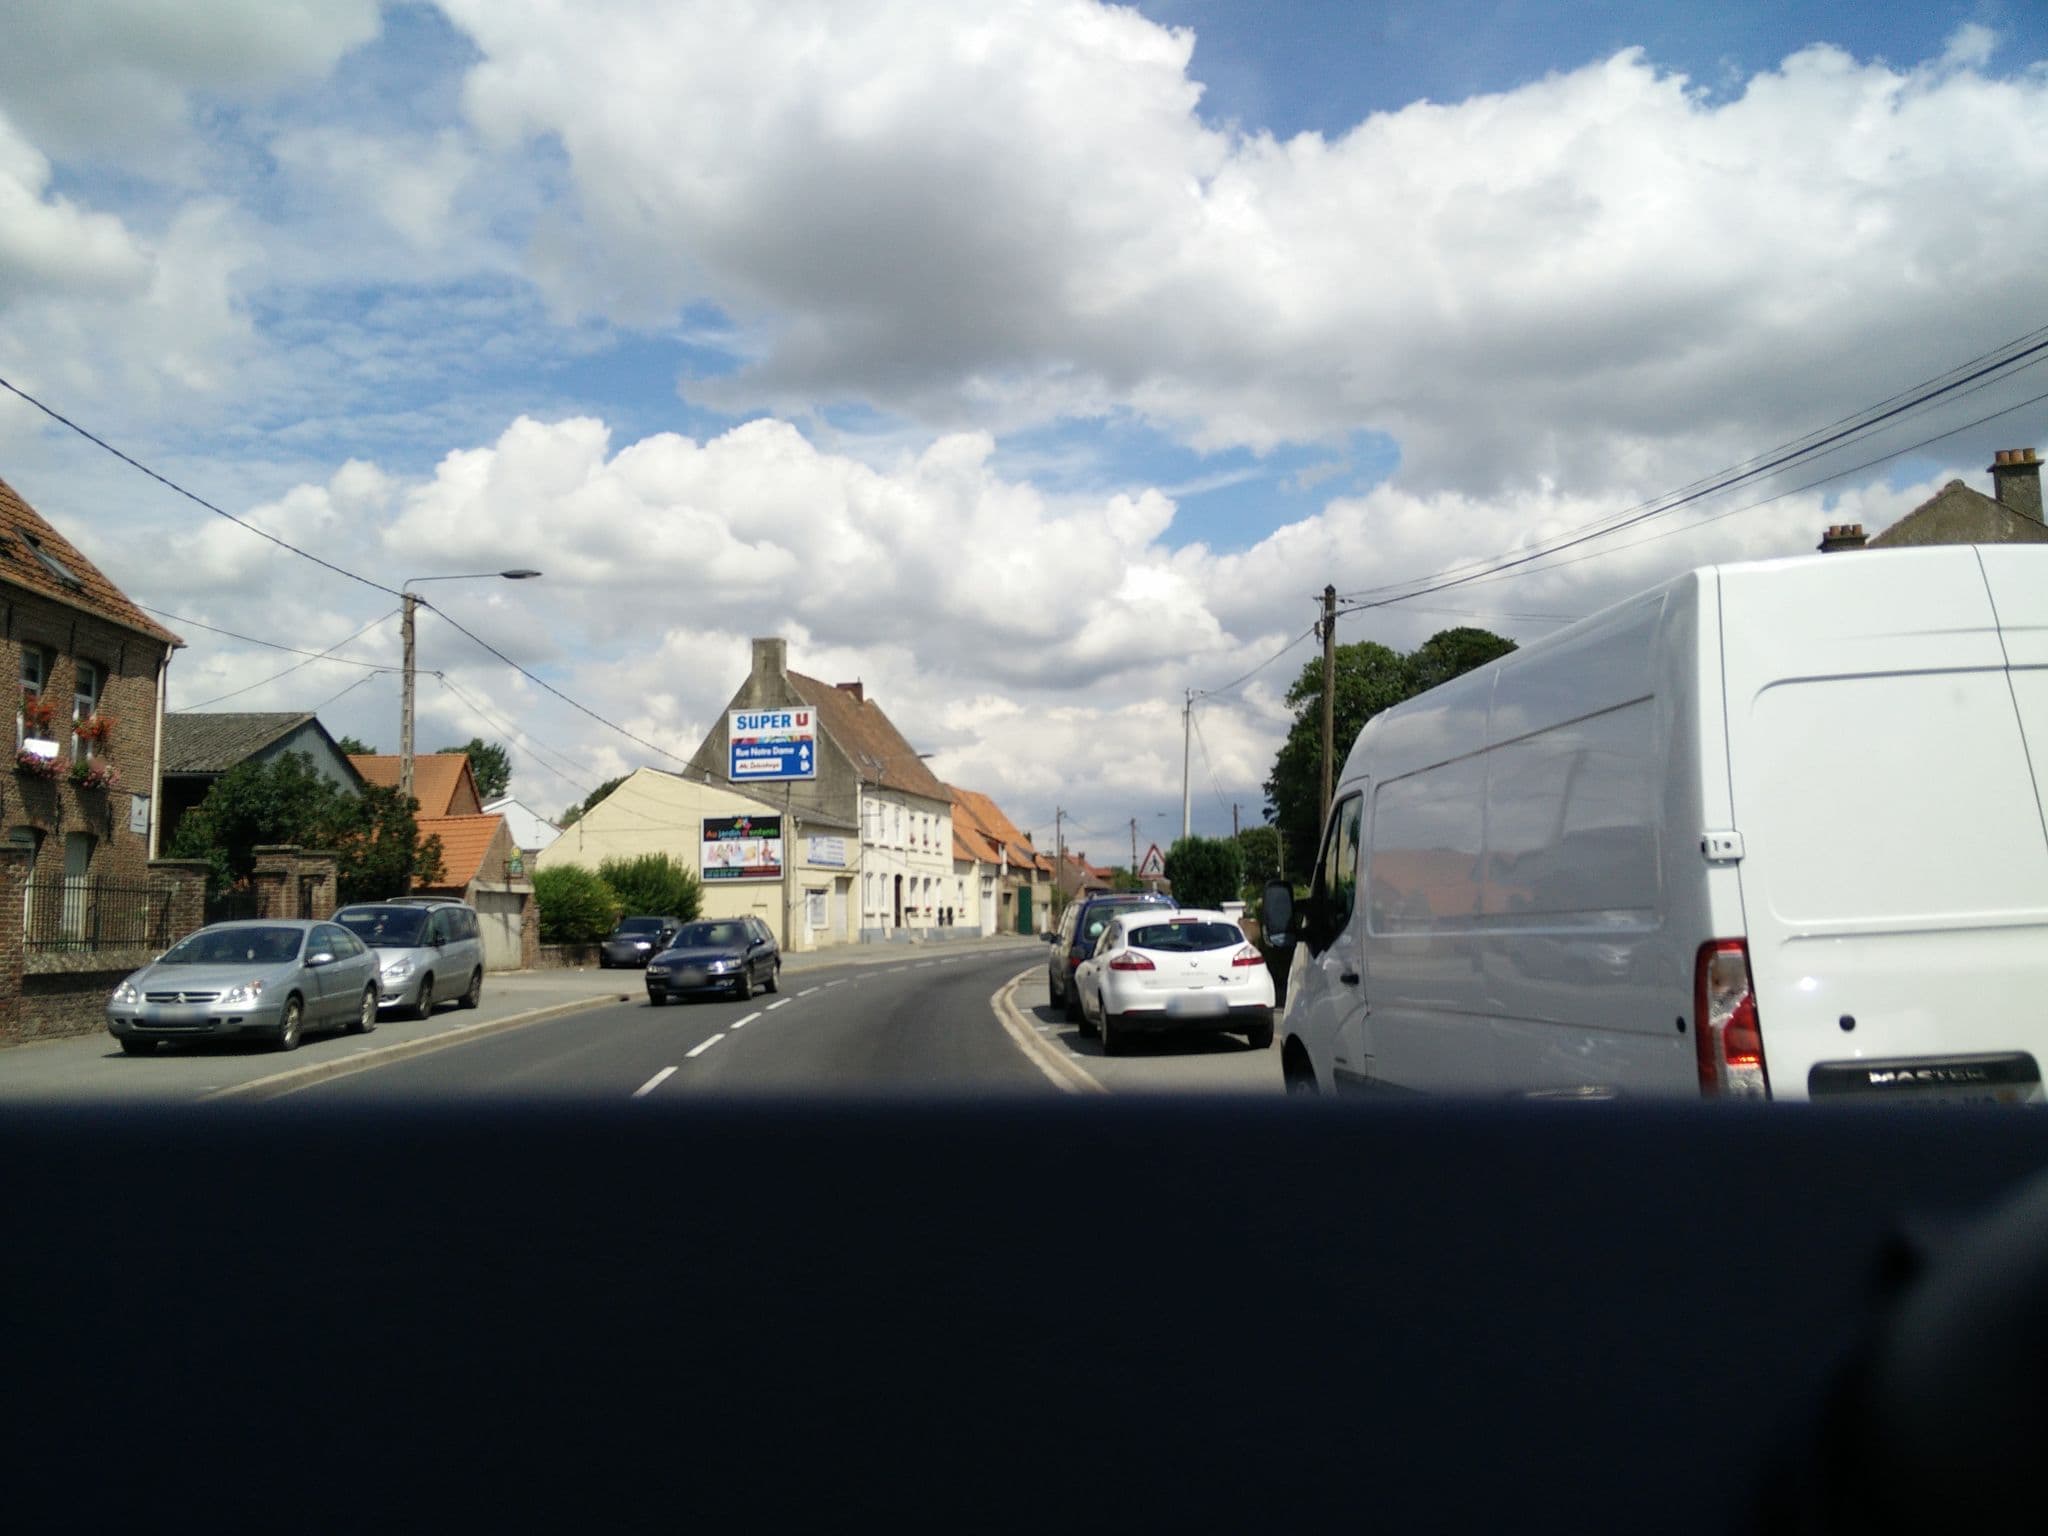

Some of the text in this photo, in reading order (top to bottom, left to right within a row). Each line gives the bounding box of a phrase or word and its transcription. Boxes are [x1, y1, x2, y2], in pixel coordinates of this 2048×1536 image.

[737, 713, 808, 729] SUPER U
[736, 746, 795, 757] Rue Notre Dame
[1868, 1069, 1987, 1083] MASTER
